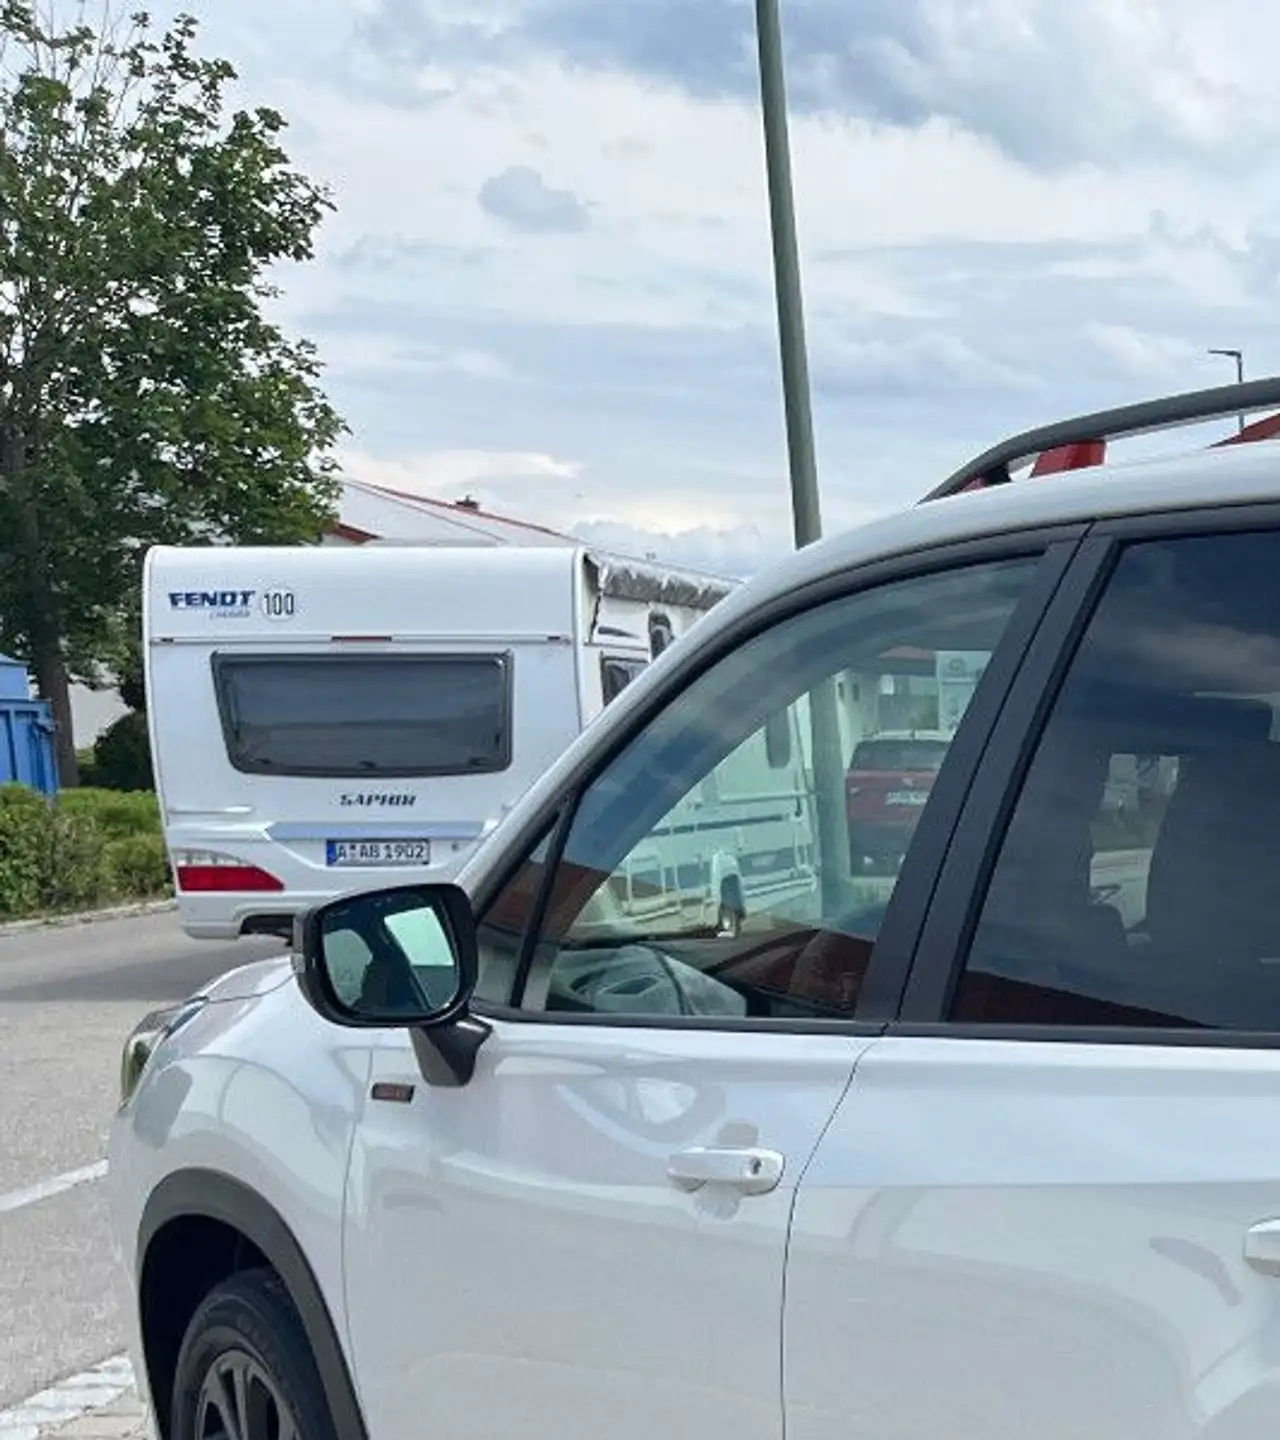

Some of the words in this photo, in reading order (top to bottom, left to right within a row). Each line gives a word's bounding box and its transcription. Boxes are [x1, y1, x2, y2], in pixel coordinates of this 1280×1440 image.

[168, 588, 256, 607] FENDT
[263, 592, 295, 616] 100
[384, 844, 425, 859] 1902
